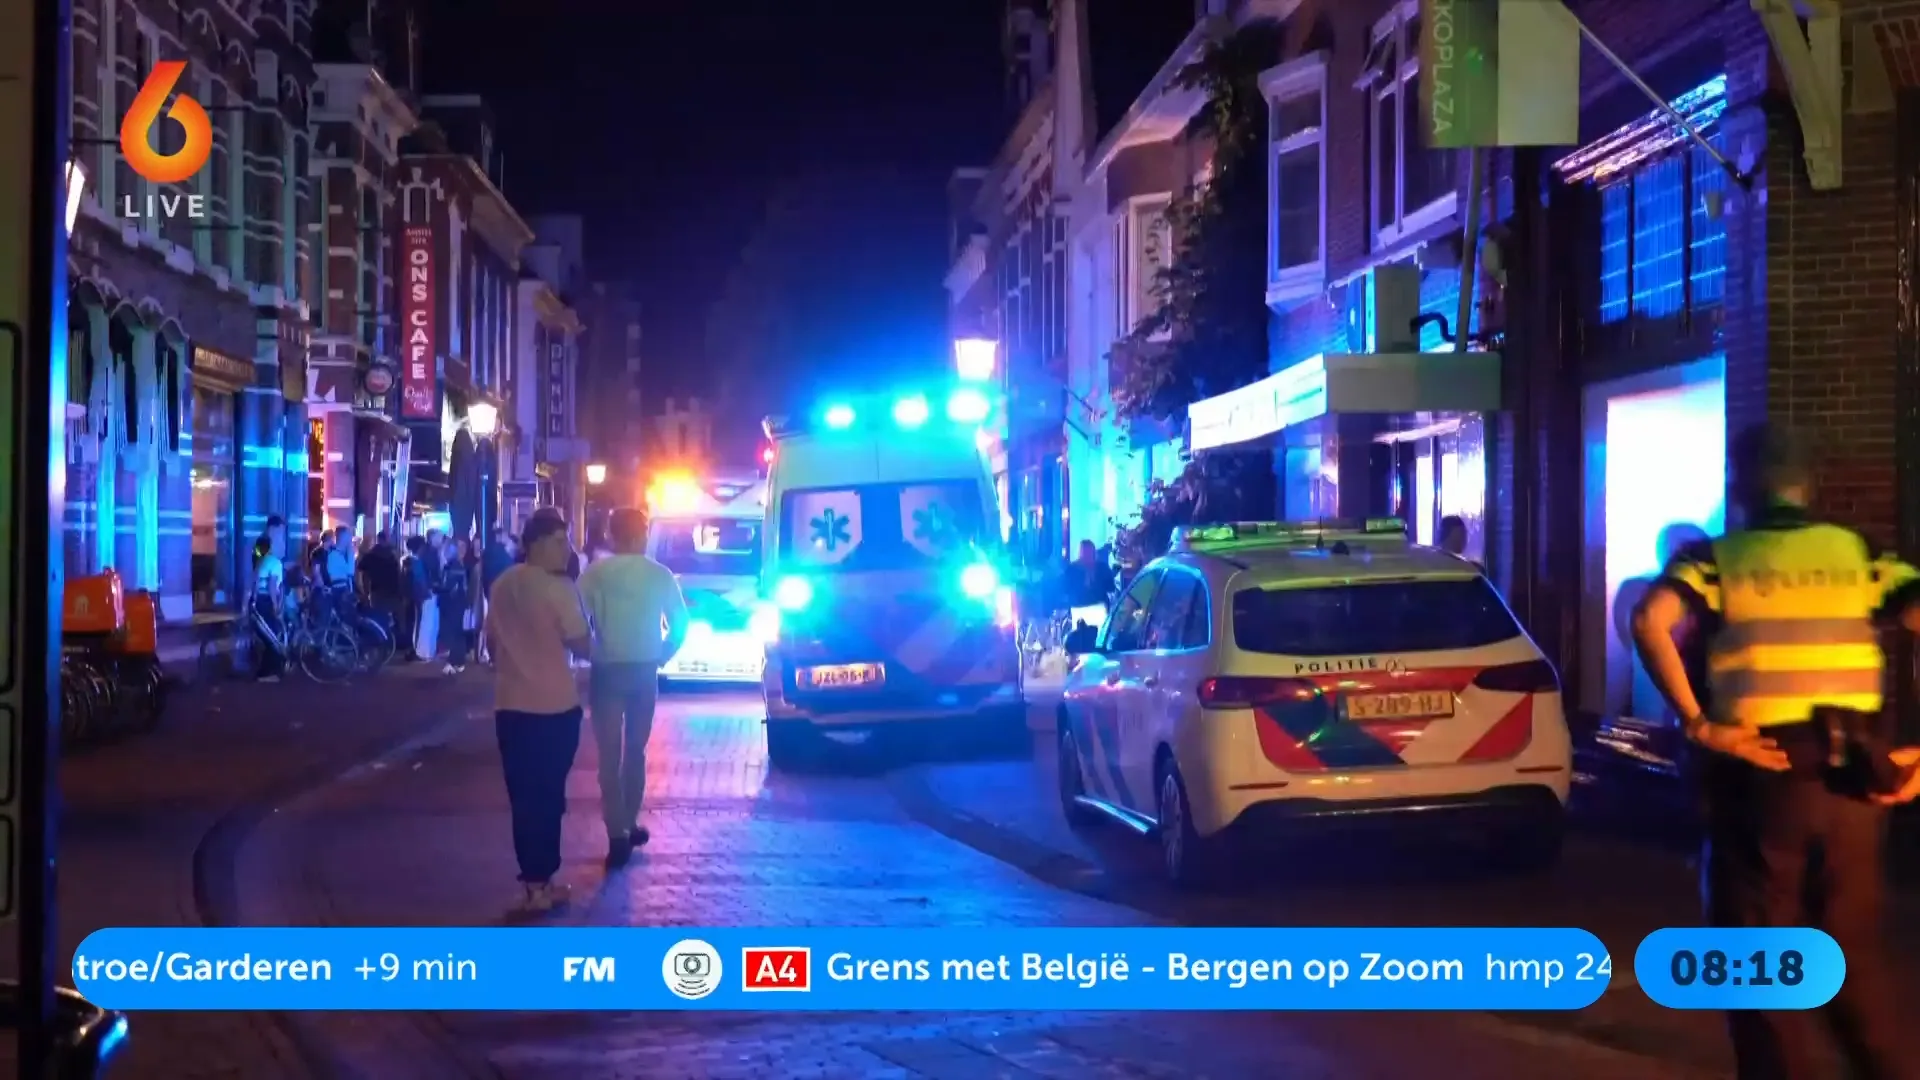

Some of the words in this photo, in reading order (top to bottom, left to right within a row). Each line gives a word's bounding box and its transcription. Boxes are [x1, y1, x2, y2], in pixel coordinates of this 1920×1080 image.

[1432, 0, 1455, 135] KOPLAZA
[411, 250, 429, 302] ONS
[410, 311, 429, 379] CAFE
[1294, 657, 1378, 674] POLITIE
